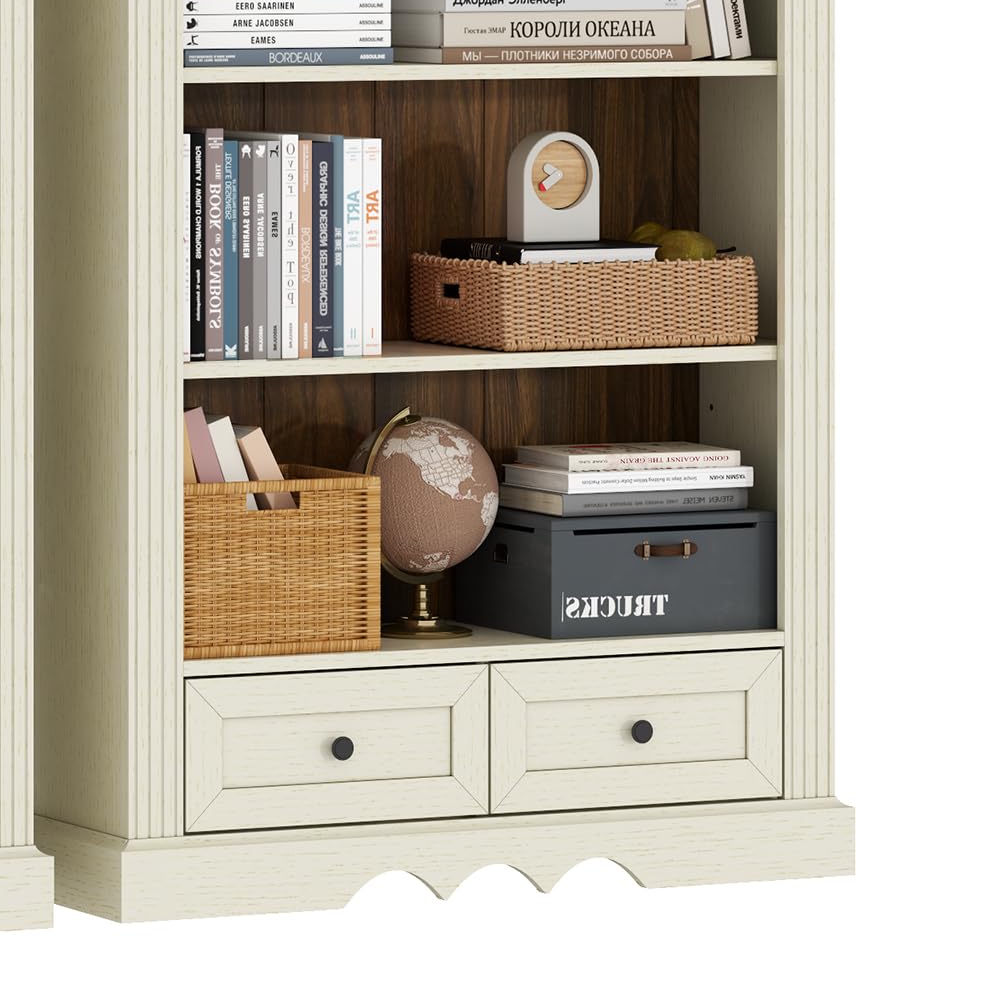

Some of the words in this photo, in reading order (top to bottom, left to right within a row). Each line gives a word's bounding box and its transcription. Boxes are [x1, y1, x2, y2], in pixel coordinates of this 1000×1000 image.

[235, 2, 255, 10] EERO
[257, 2, 295, 10] SAARINEN
[233, 19, 252, 27] ARNE
[255, 19, 294, 27] JACOBSEN
[510, 21, 581, 38] КОРОЛИ
[585, 20, 656, 37] ОКЕАНА
[251, 36, 276, 44] EAMES
[269, 52, 322, 63] BORDEAUX
[462, 51, 481, 61] МЫ
[502, 50, 559, 61] ПЛОТНИКИ
[563, 49, 628, 60] НЕЗРИМОГО
[631, 48, 673, 59] СОБОРА
[620, 457, 646, 465] GRAIN
[666, 456, 701, 464] AGAINST
[703, 455, 729, 463] GOING
